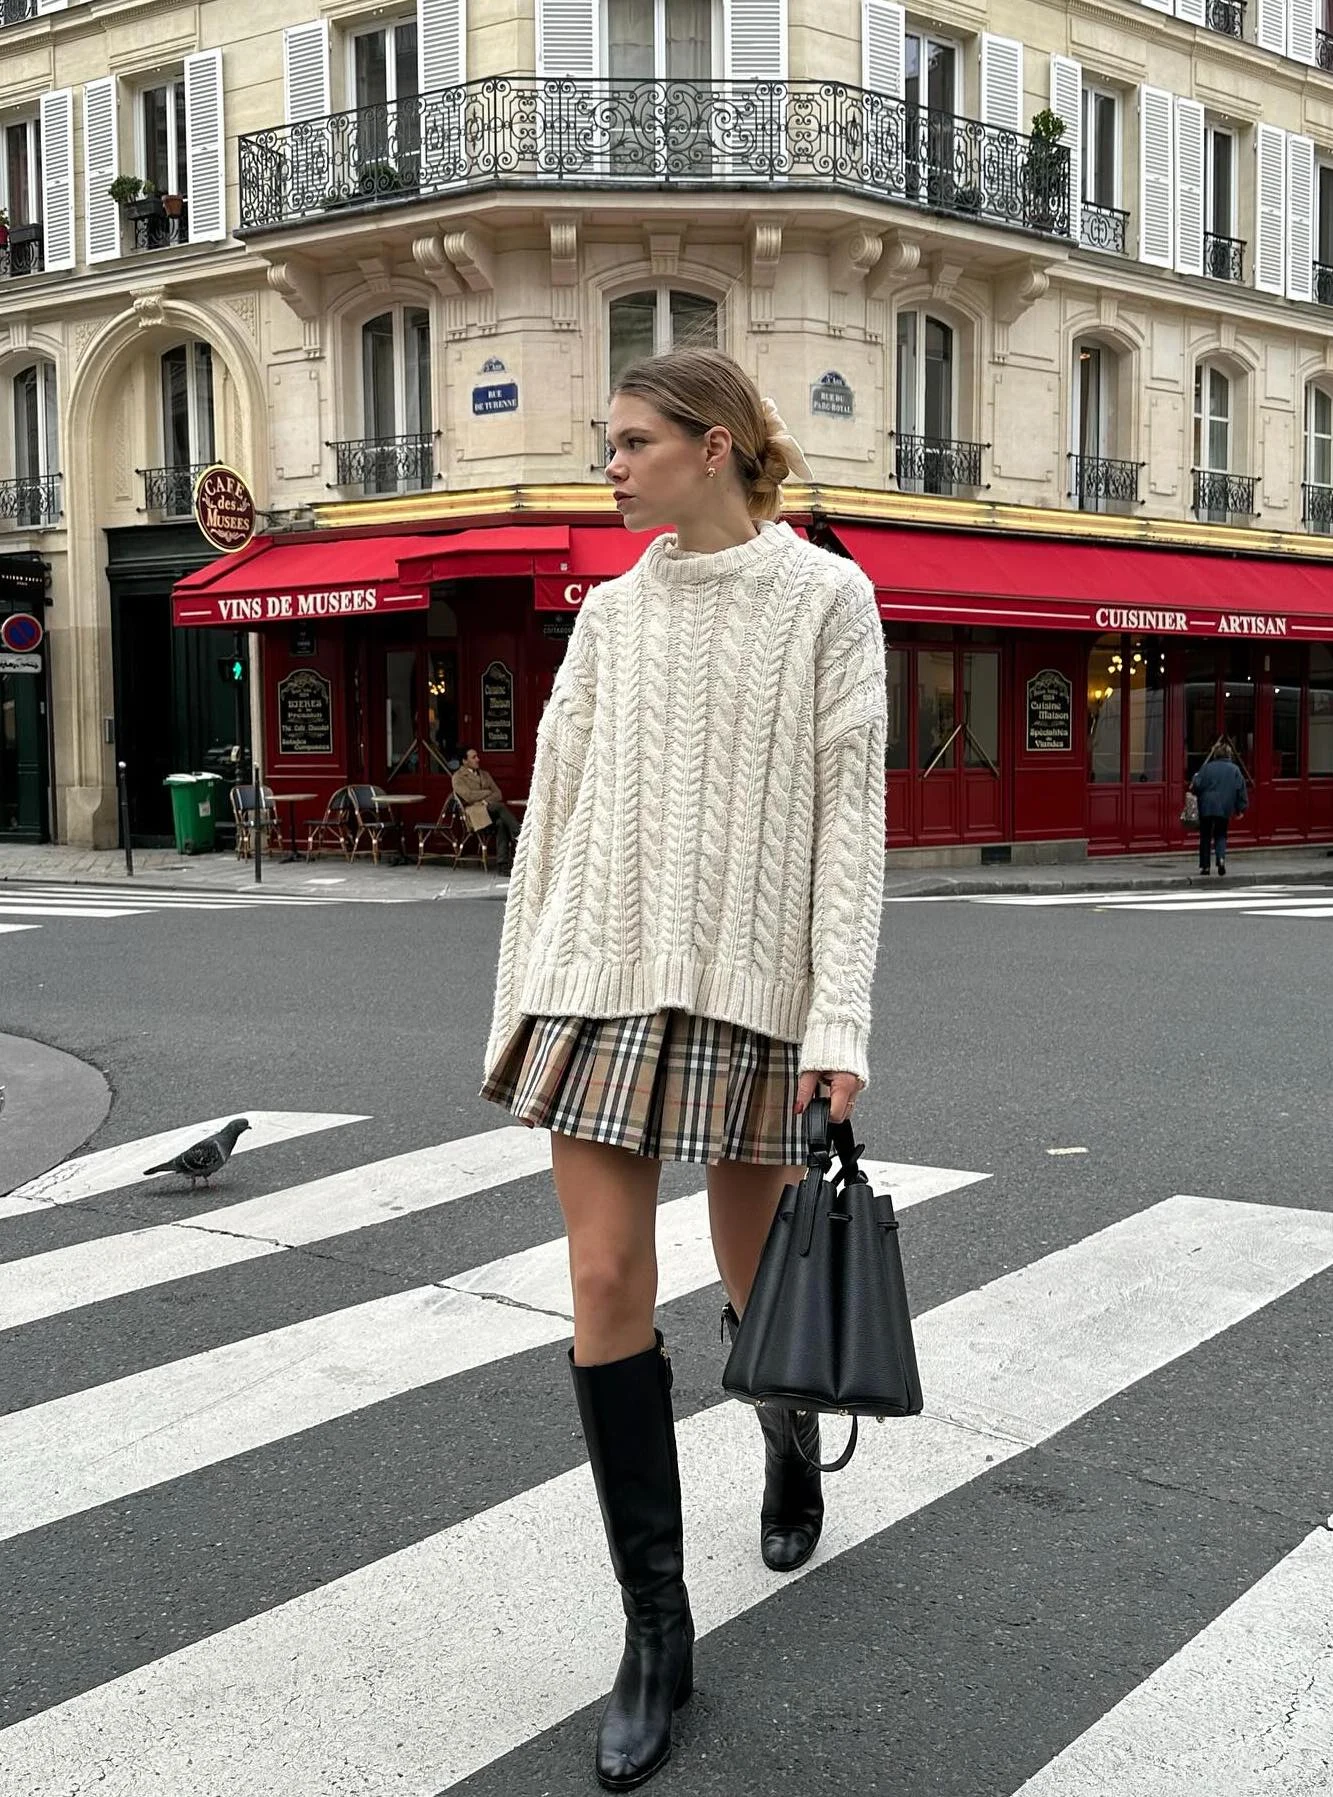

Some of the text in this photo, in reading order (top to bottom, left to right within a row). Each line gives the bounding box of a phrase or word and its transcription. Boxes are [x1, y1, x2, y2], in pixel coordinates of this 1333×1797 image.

[488, 390, 502, 399] RUE
[821, 391, 834, 401] RUE
[474, 399, 516, 411] DE TURENNE
[217, 495, 236, 511] des
[218, 589, 377, 620] VINS DE MUSEES
[1095, 608, 1287, 635] CUISINIER ARTISAN
[1030, 701, 1061, 710] Cuisine
[1038, 710, 1069, 720] Maison
